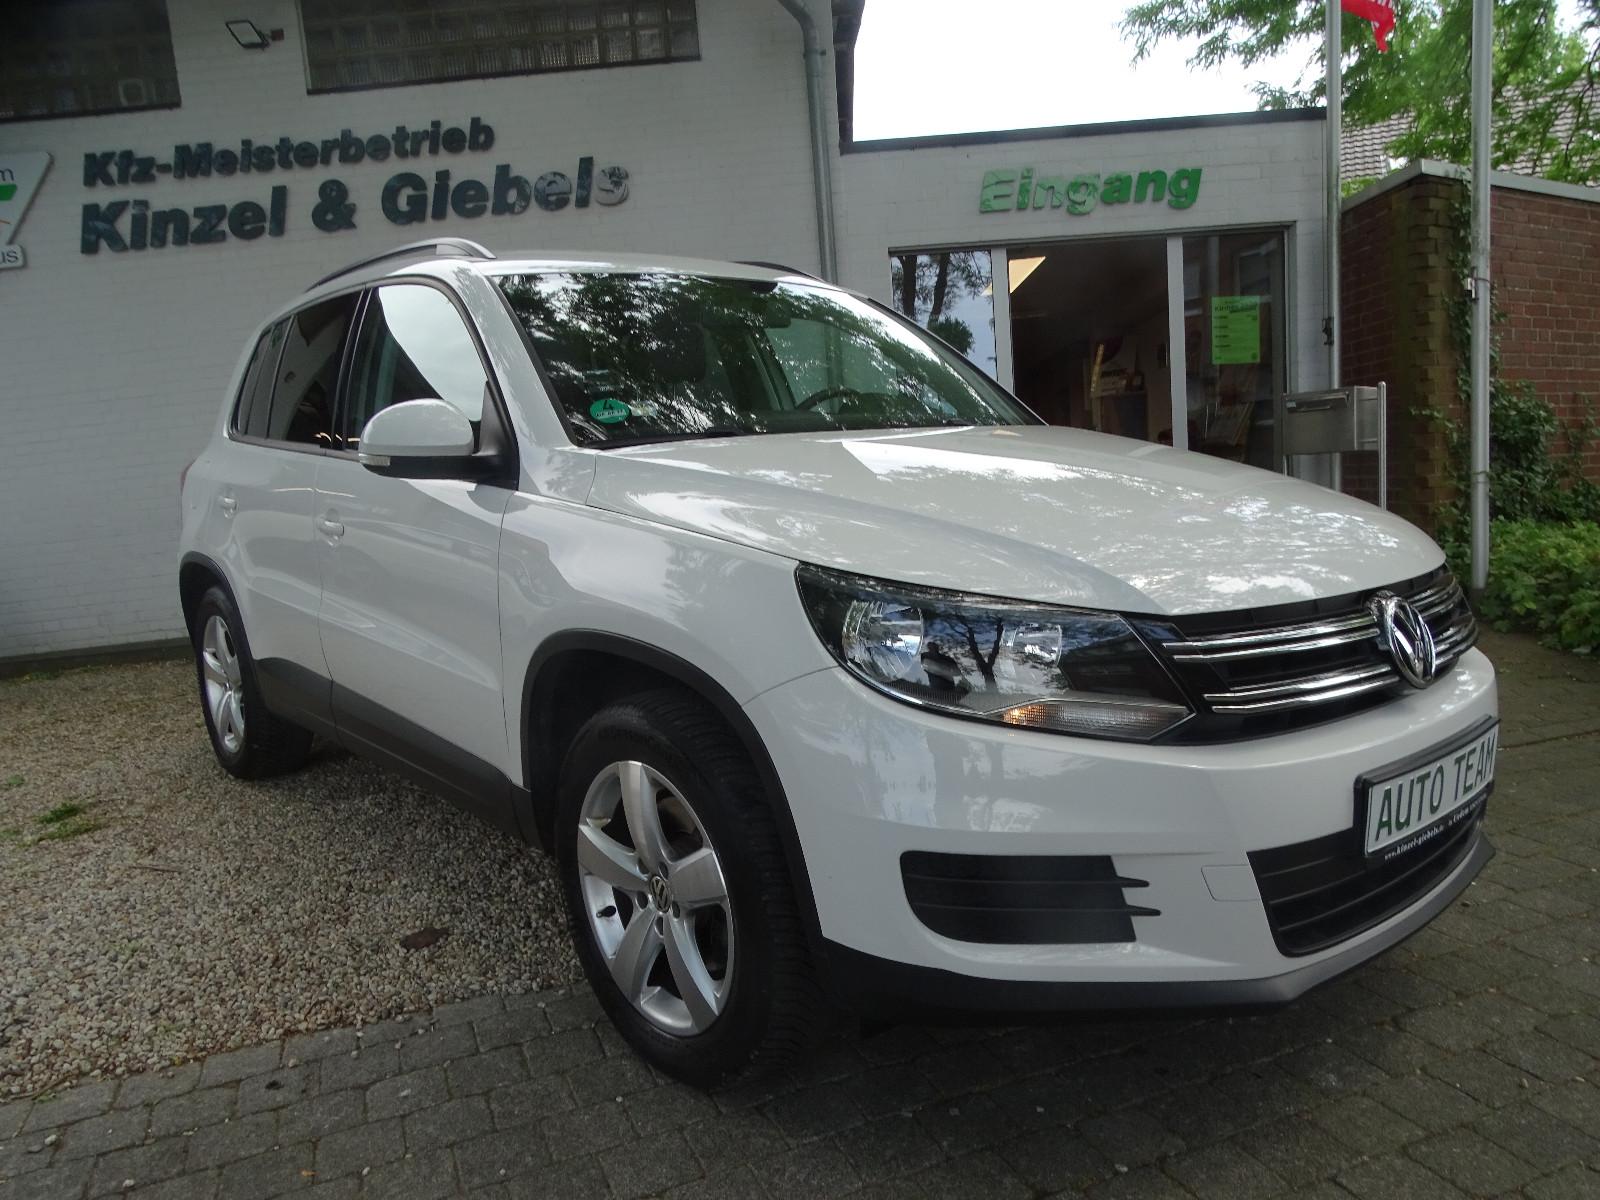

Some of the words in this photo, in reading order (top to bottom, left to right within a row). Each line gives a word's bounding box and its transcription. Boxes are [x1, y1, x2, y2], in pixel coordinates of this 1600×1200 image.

[83, 117, 495, 187] Kfz-Meisterbetrieb
[979, 167, 1202, 216] Eingang
[81, 185, 287, 254] Kinzel
[311, 179, 357, 232] &
[381, 156, 630, 225] Giebels
[1375, 764, 1444, 841] AUTO
[1453, 732, 1496, 802] TEAM
